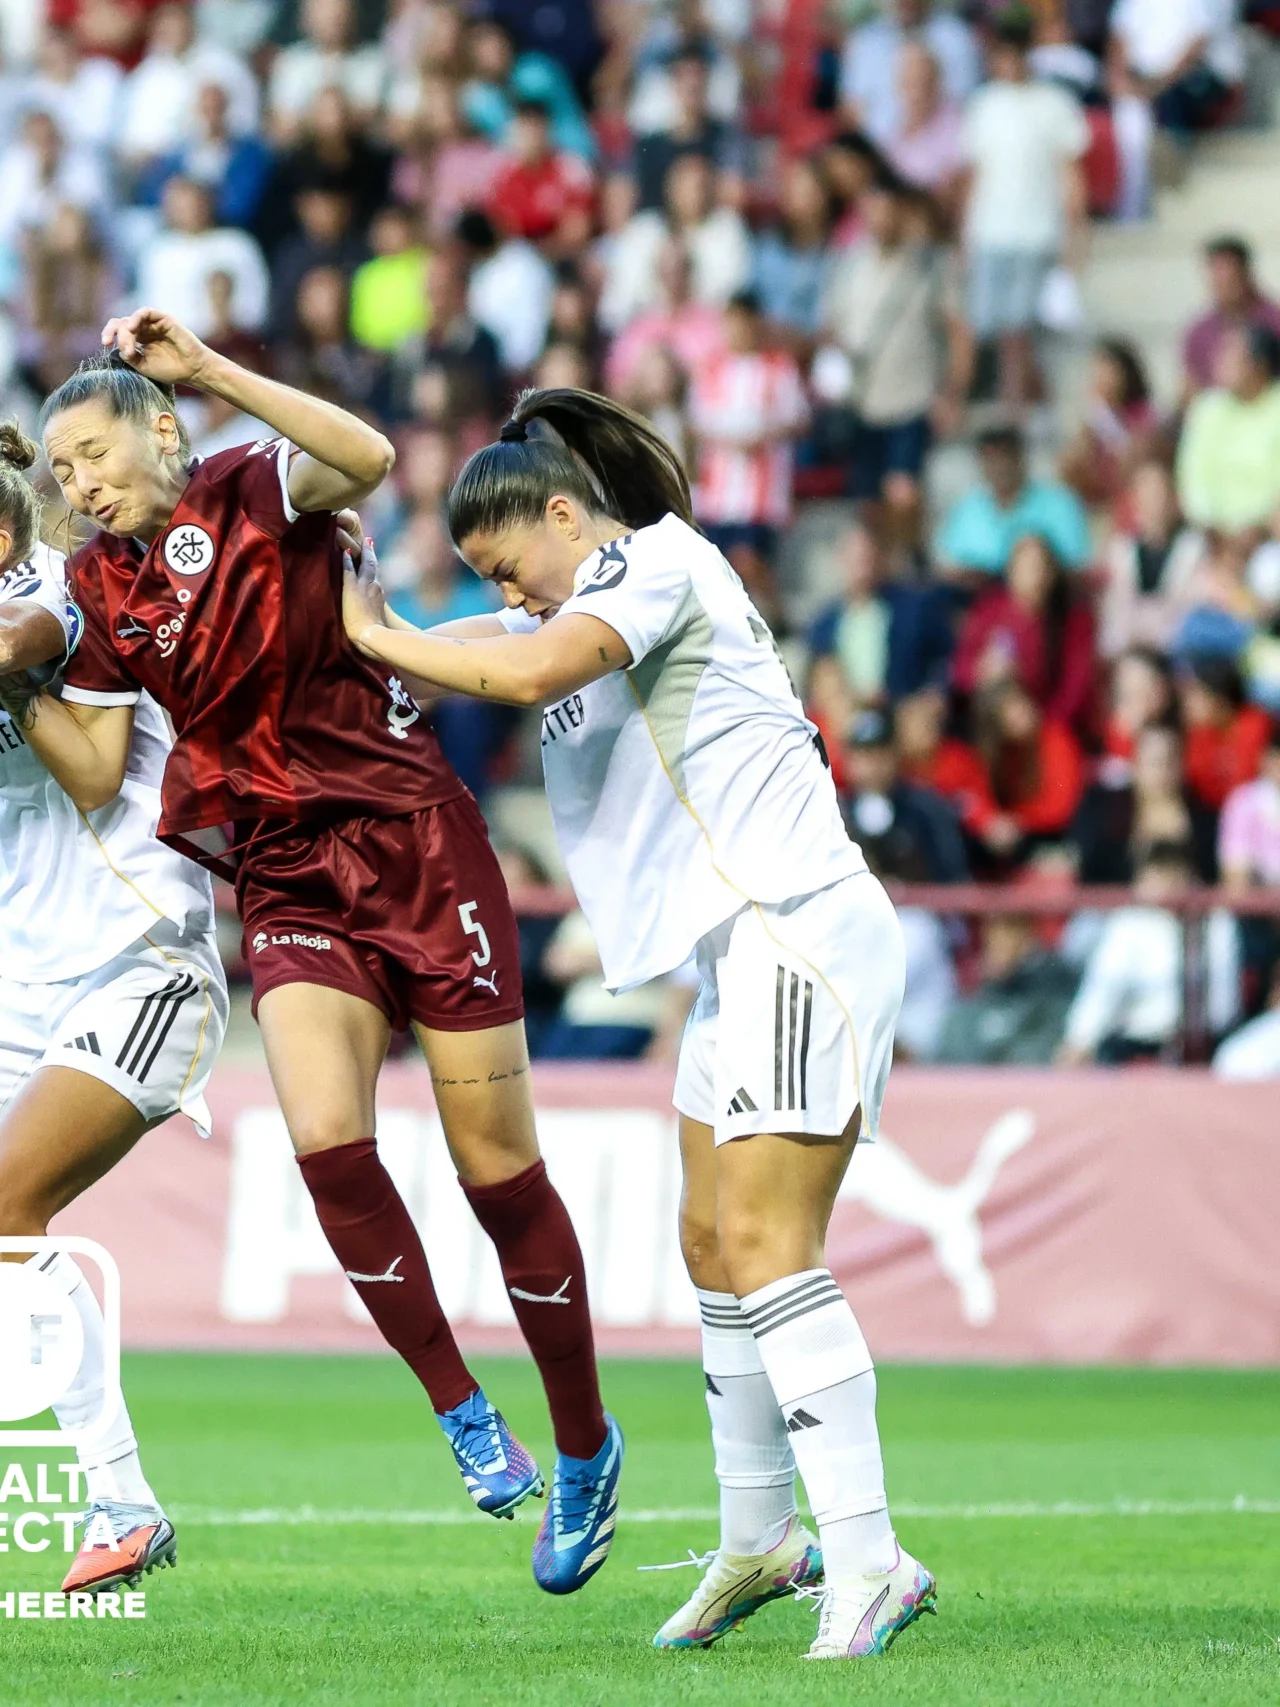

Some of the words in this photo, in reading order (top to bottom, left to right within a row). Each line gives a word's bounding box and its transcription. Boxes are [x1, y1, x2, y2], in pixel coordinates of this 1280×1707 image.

[271, 935, 291, 945] La
[291, 933, 332, 951] Rioja
[457, 900, 491, 968] 5
